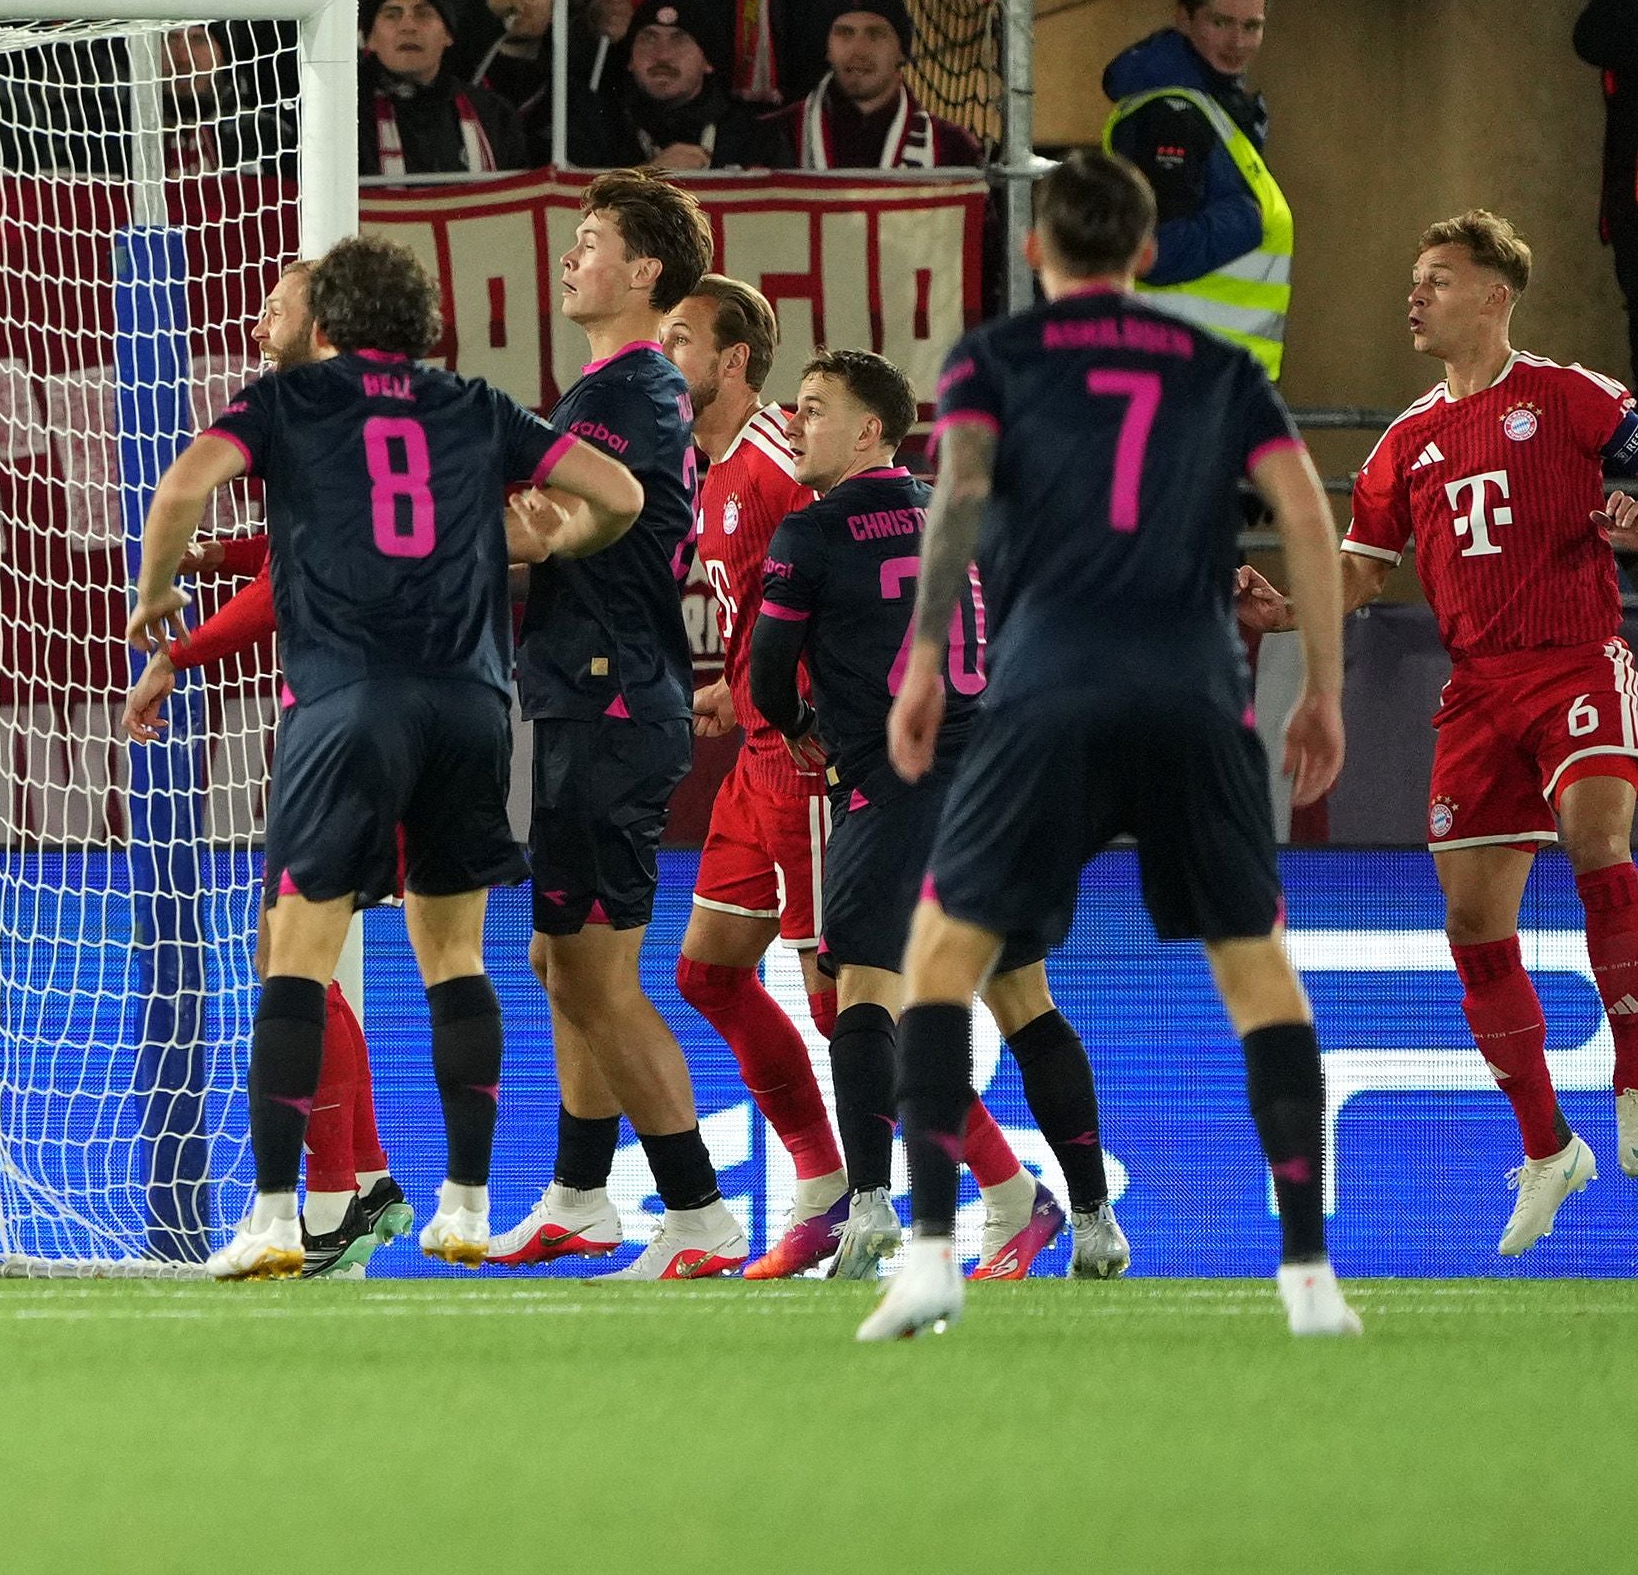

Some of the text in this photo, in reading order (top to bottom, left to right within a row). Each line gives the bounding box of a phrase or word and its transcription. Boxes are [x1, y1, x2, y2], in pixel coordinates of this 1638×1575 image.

[361, 415, 437, 559] 8
[1085, 367, 1164, 535] 7
[1444, 469, 1514, 558] T
[1567, 693, 1600, 739] 6
